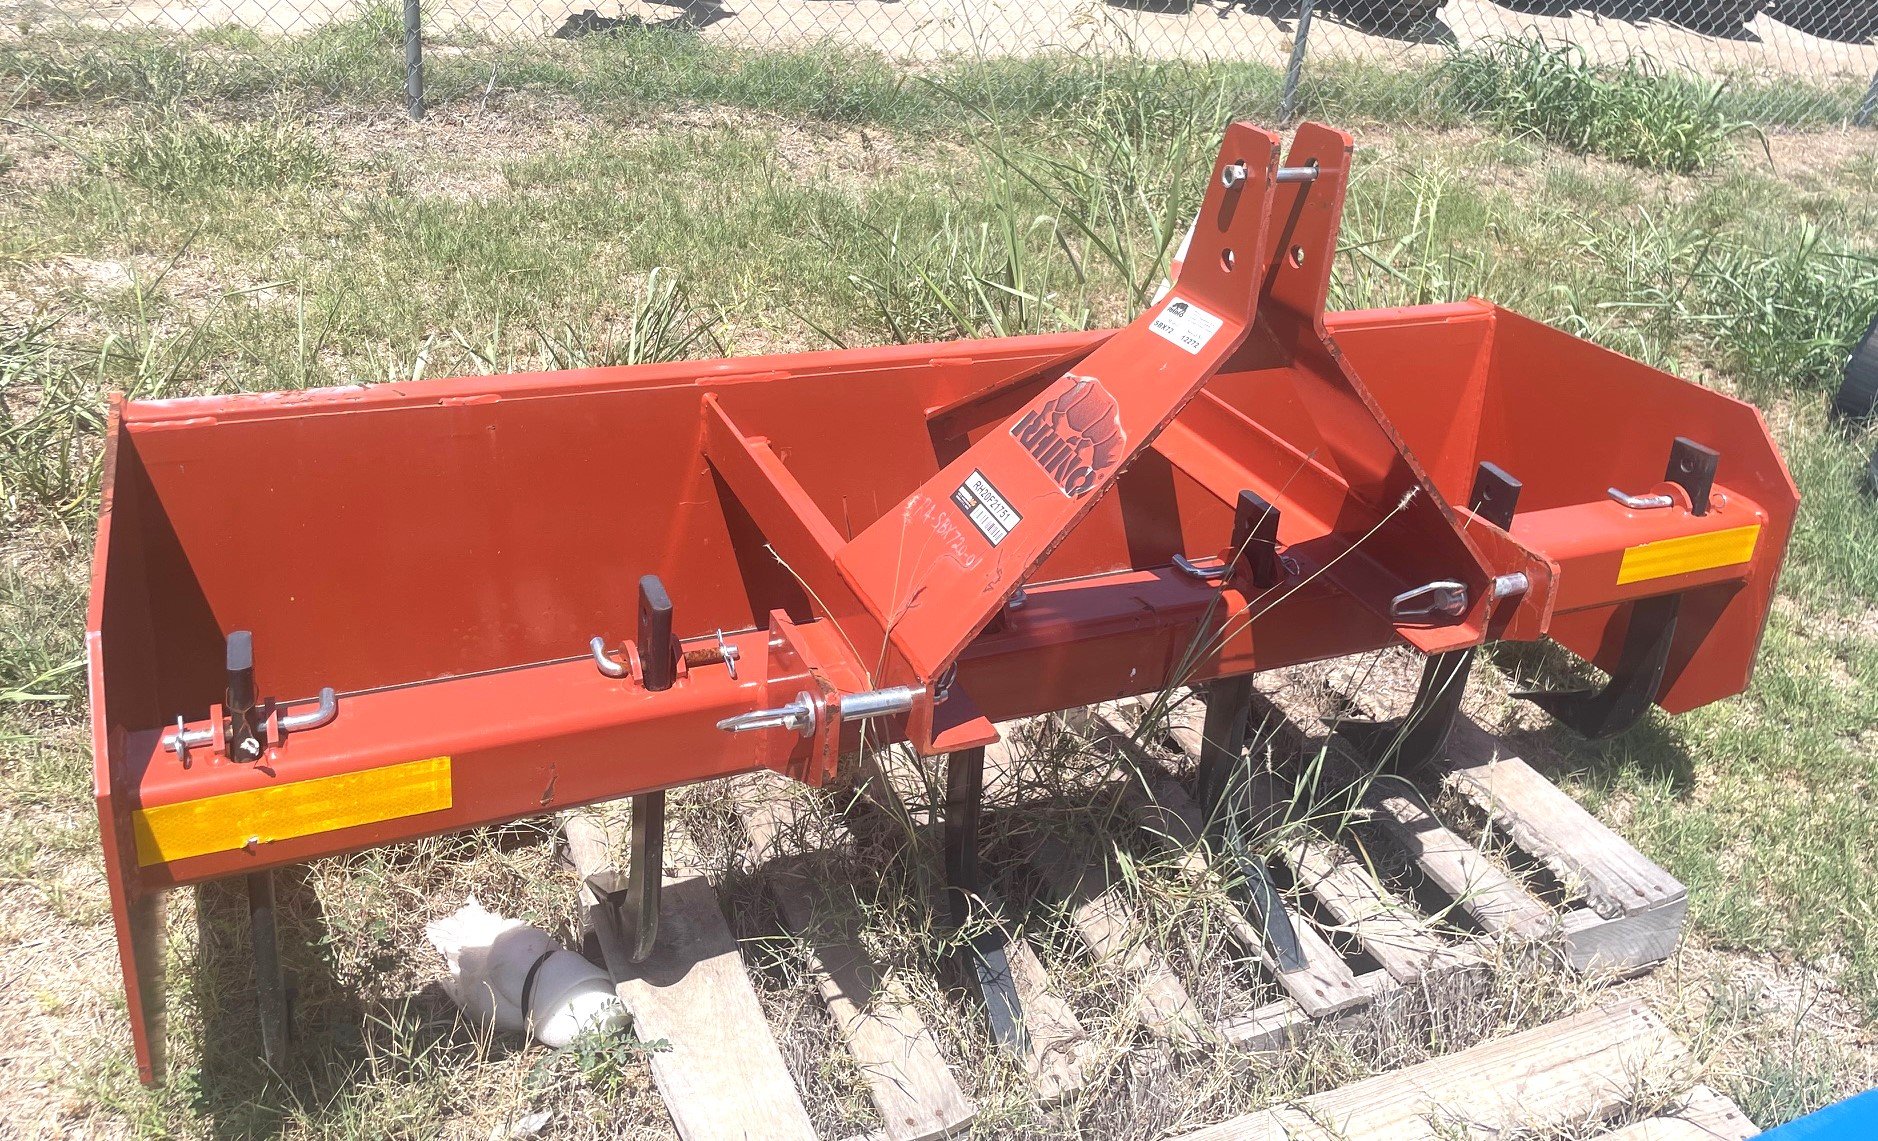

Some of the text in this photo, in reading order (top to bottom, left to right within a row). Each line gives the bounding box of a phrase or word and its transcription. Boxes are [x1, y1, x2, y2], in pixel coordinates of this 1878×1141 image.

[1180, 335, 1200, 349] 12272
[1010, 409, 1096, 498] RHINO
[972, 480, 1011, 522] RH20F21751
